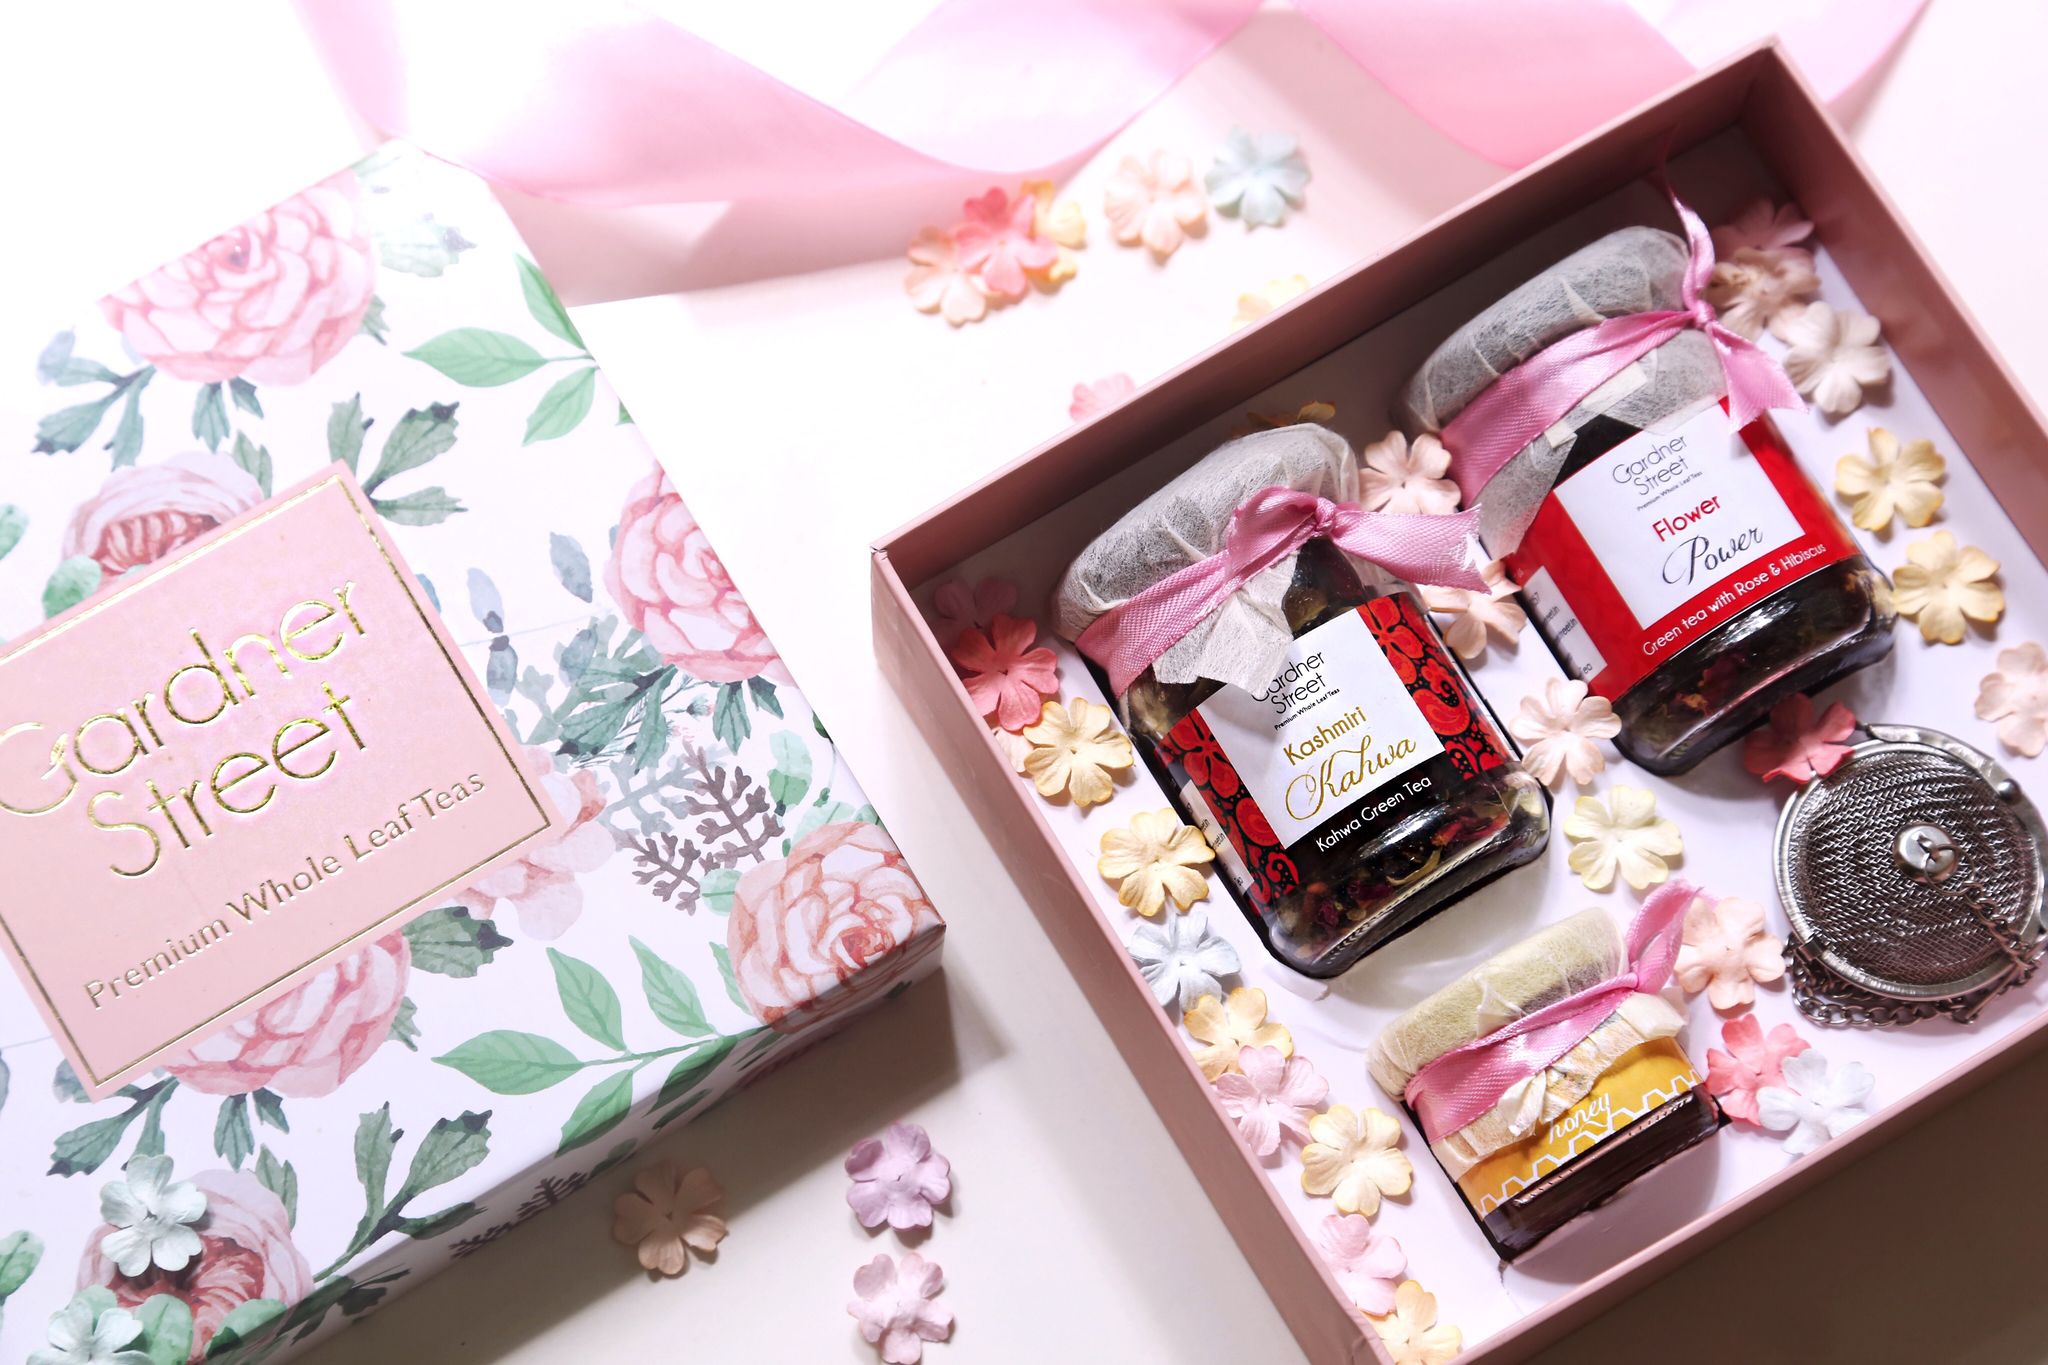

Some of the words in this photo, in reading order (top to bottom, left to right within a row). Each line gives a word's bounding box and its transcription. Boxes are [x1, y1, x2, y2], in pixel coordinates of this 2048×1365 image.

[1613, 436, 1687, 484] Gardner
[1633, 455, 1688, 495] Street
[1652, 496, 1721, 542] Flower
[1662, 527, 1763, 585] Power
[1642, 625, 1682, 656] Green
[1681, 610, 1708, 630] tea
[1707, 590, 1736, 612] with
[1733, 572, 1770, 596] Rose
[1769, 563, 1781, 576] &
[1779, 544, 1826, 571] Hibiscus
[0, 580, 367, 816] Gardner
[1271, 672, 1326, 714] Street
[1274, 714, 1298, 731] Premium
[1297, 702, 1316, 715] Whole
[1316, 694, 1328, 704] Leaf
[1327, 688, 1340, 697] Teas
[1283, 706, 1367, 766] Kashmiri
[86, 681, 367, 878] Street
[1285, 735, 1416, 820] Kahwa
[1316, 818, 1362, 852] Kahwa
[1360, 793, 1405, 821] Green
[1403, 776, 1432, 796] Tea
[83, 918, 232, 1010] Premium
[225, 857, 343, 924] Whole
[344, 802, 415, 862] Leaf
[410, 773, 485, 820] Teas
